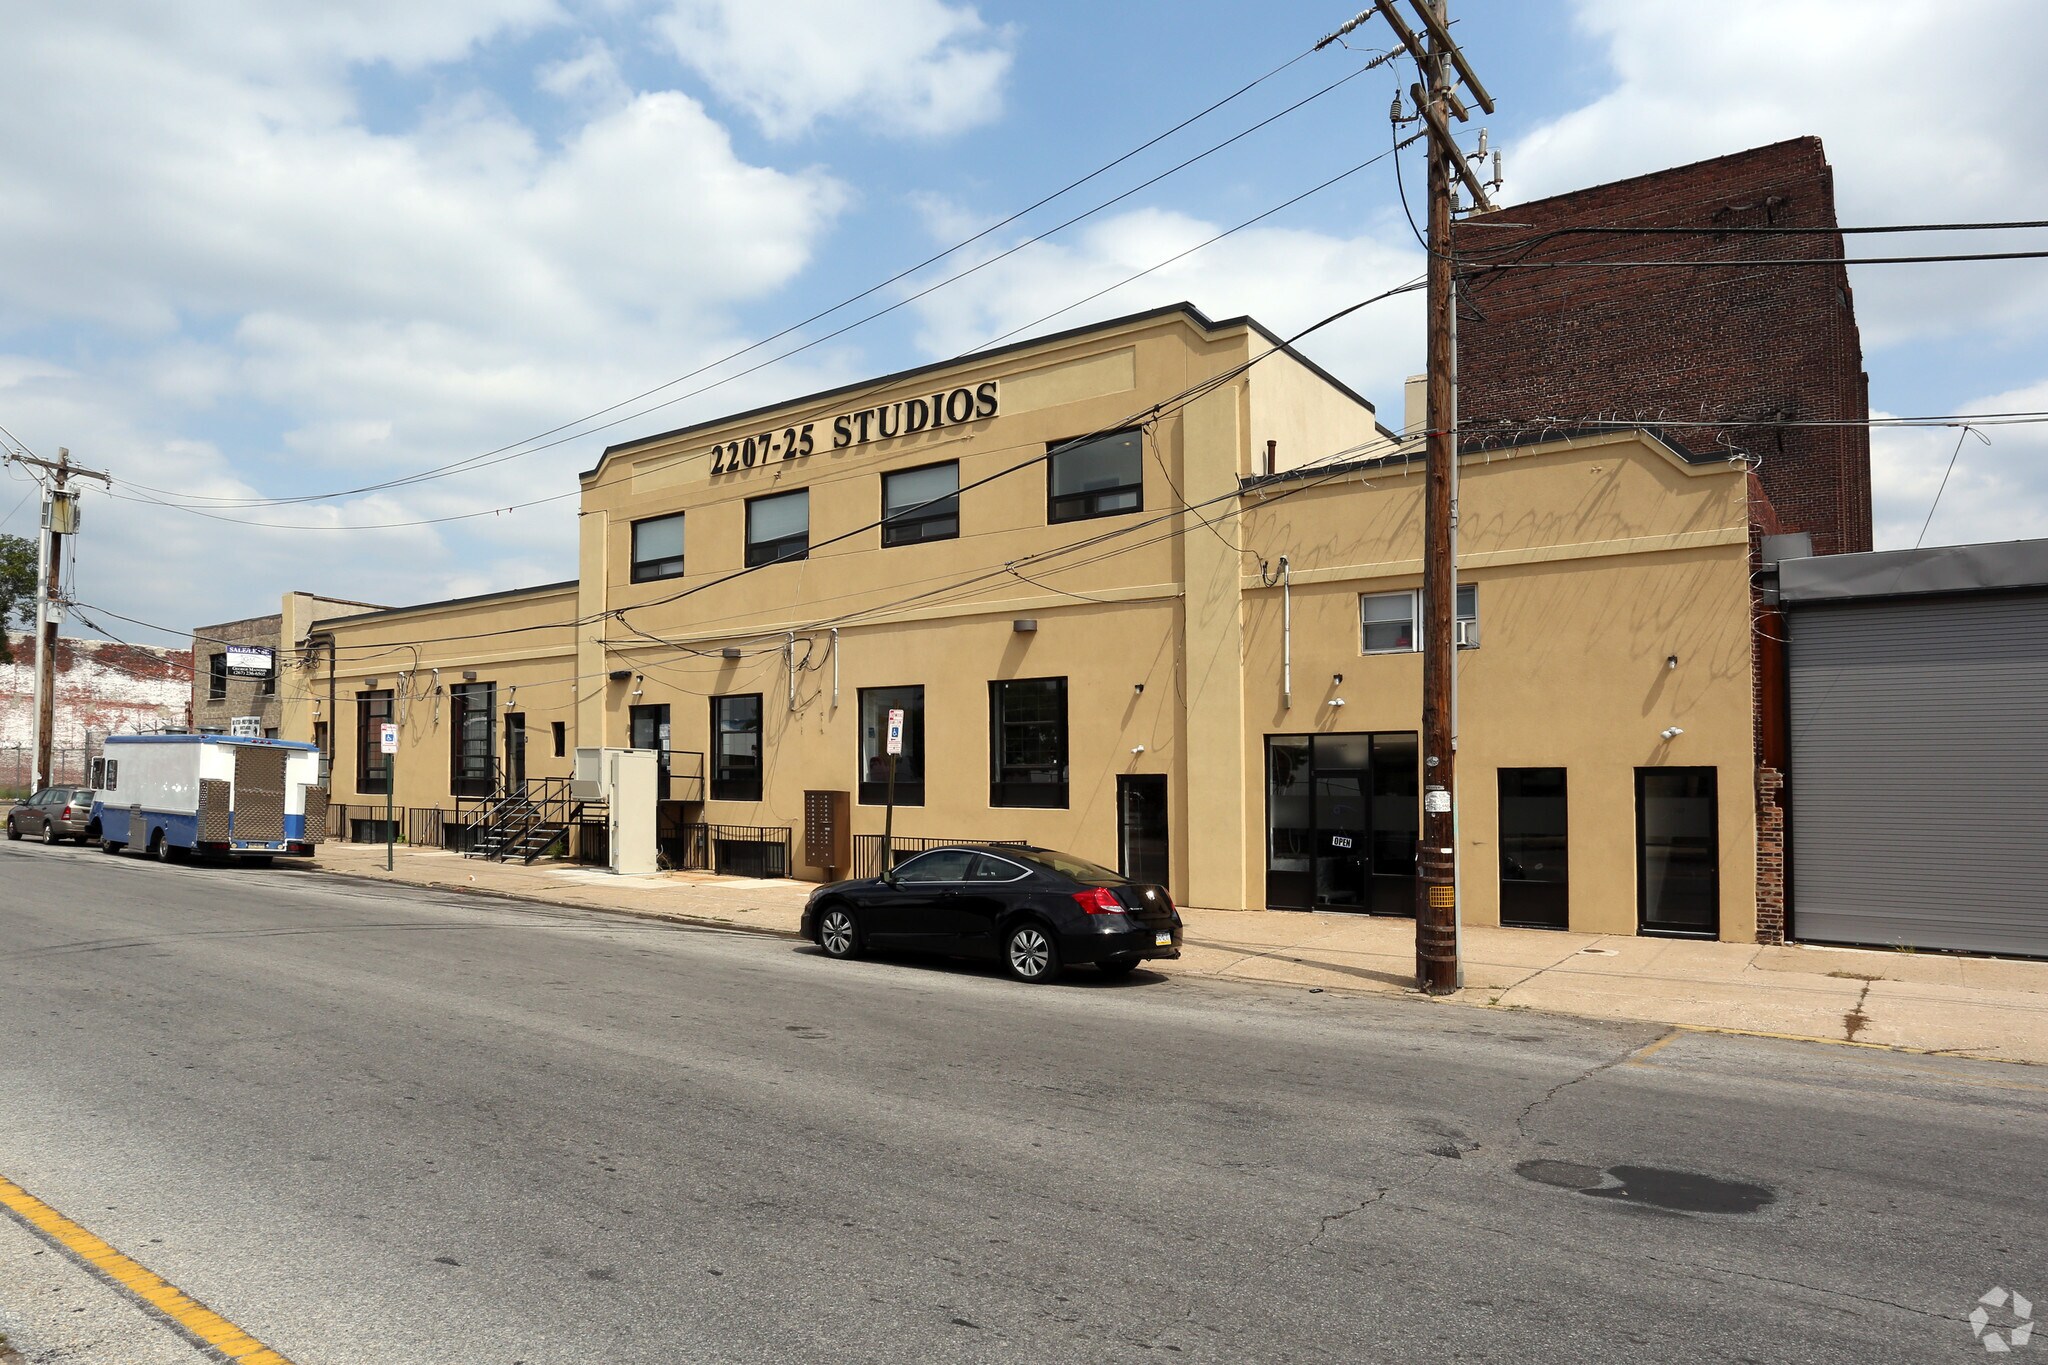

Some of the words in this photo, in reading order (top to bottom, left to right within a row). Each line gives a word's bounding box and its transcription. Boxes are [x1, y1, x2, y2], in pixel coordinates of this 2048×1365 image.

[710, 424, 814, 475] 2207-25
[833, 381, 998, 449] STUDIOS
[1334, 837, 1351, 847] OPEN
